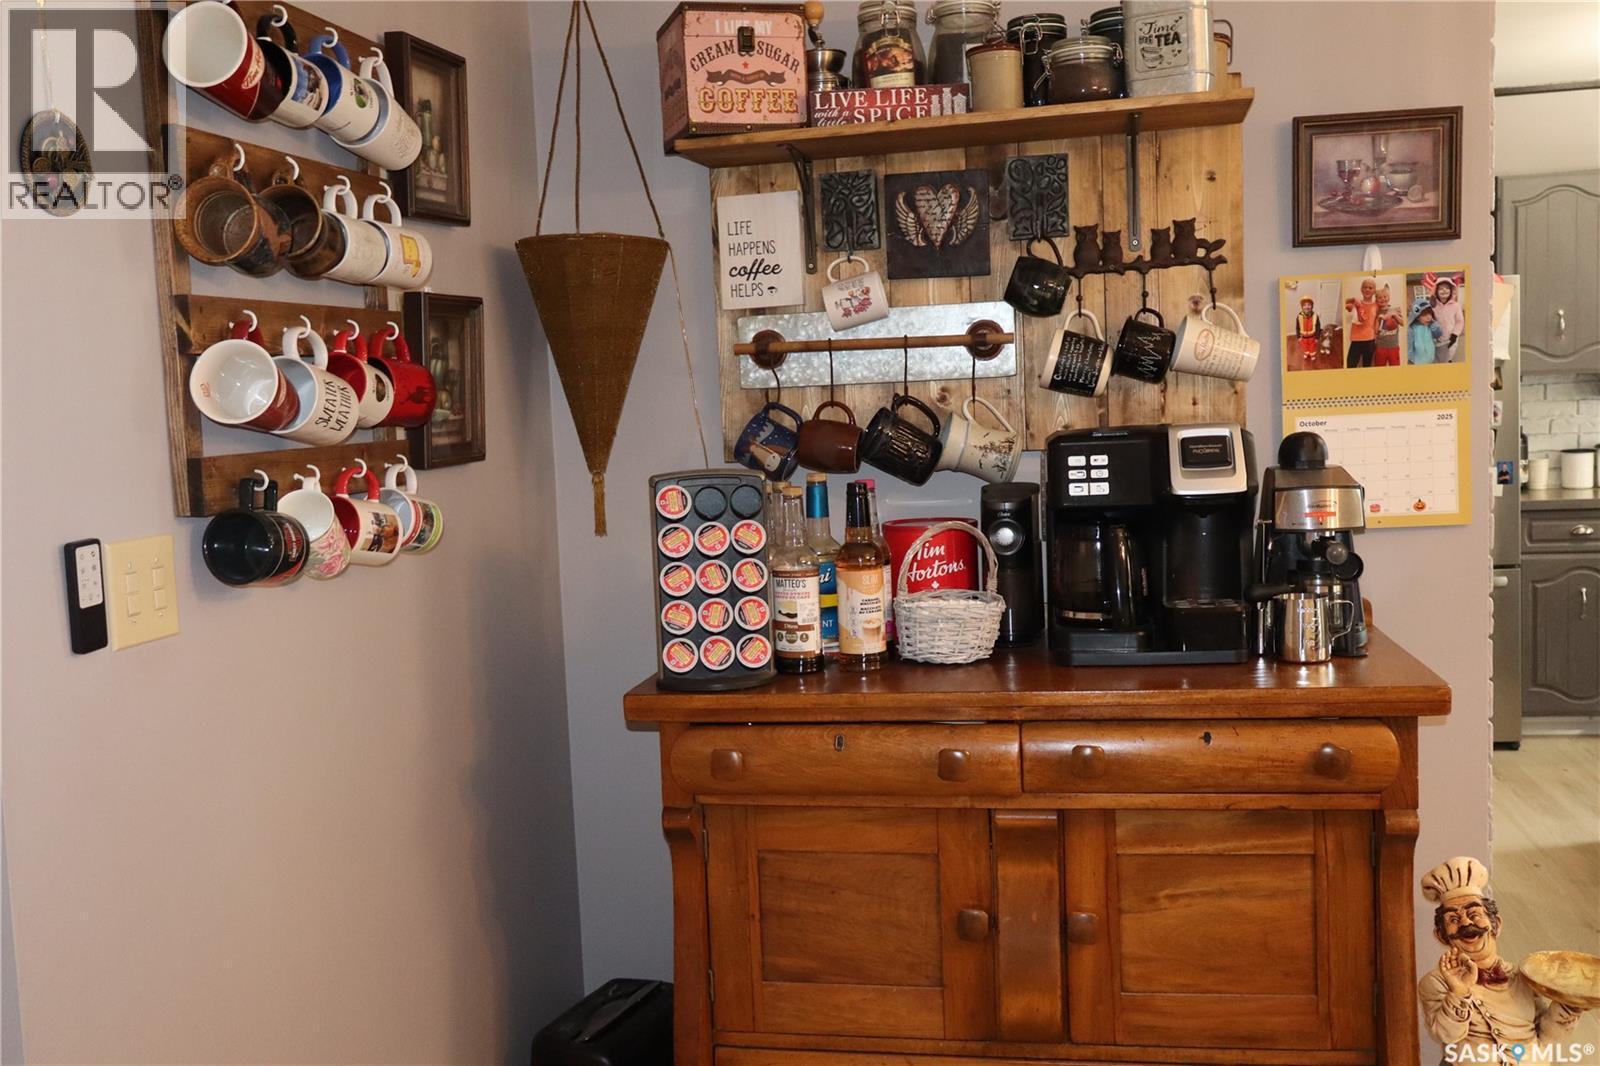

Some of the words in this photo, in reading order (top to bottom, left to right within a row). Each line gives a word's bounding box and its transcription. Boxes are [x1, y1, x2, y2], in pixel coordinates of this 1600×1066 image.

[754, 19, 774, 35] MY
[1154, 31, 1181, 47] TEA
[689, 39, 736, 72] CREAM
[756, 40, 800, 74] SUGAR
[699, 87, 799, 113] COFFEE
[814, 91, 868, 110] LIVE
[874, 87, 928, 107] LIFE
[814, 107, 839, 118] with
[853, 105, 928, 124] SPICE
[727, 220, 752, 236] LIFE
[728, 240, 776, 256] HAPPENS
[729, 258, 783, 281] coffee
[730, 282, 764, 298] HELPS
